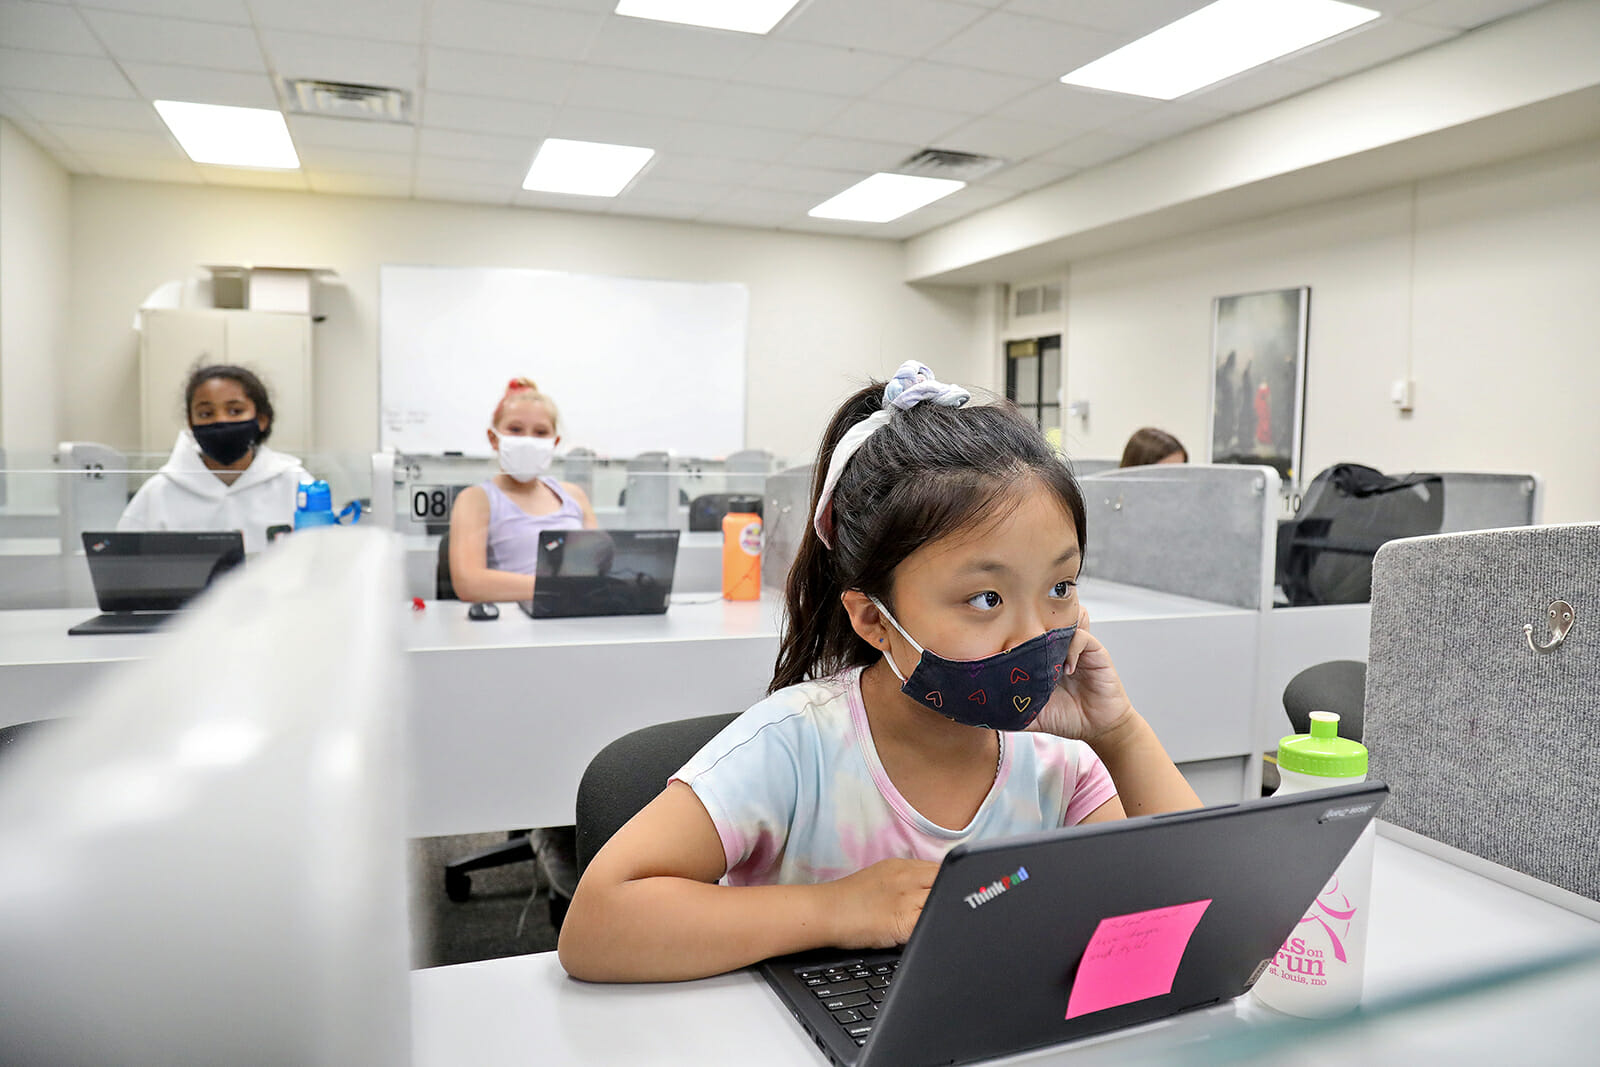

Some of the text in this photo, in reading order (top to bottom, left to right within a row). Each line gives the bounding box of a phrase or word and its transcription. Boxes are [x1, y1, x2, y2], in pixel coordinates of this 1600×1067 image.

[414, 490, 446, 517] 08
[963, 866, 1029, 909] ThinkPad
[1271, 951, 1326, 977] run
[1306, 949, 1323, 958] on
[1310, 978, 1328, 986] mo
